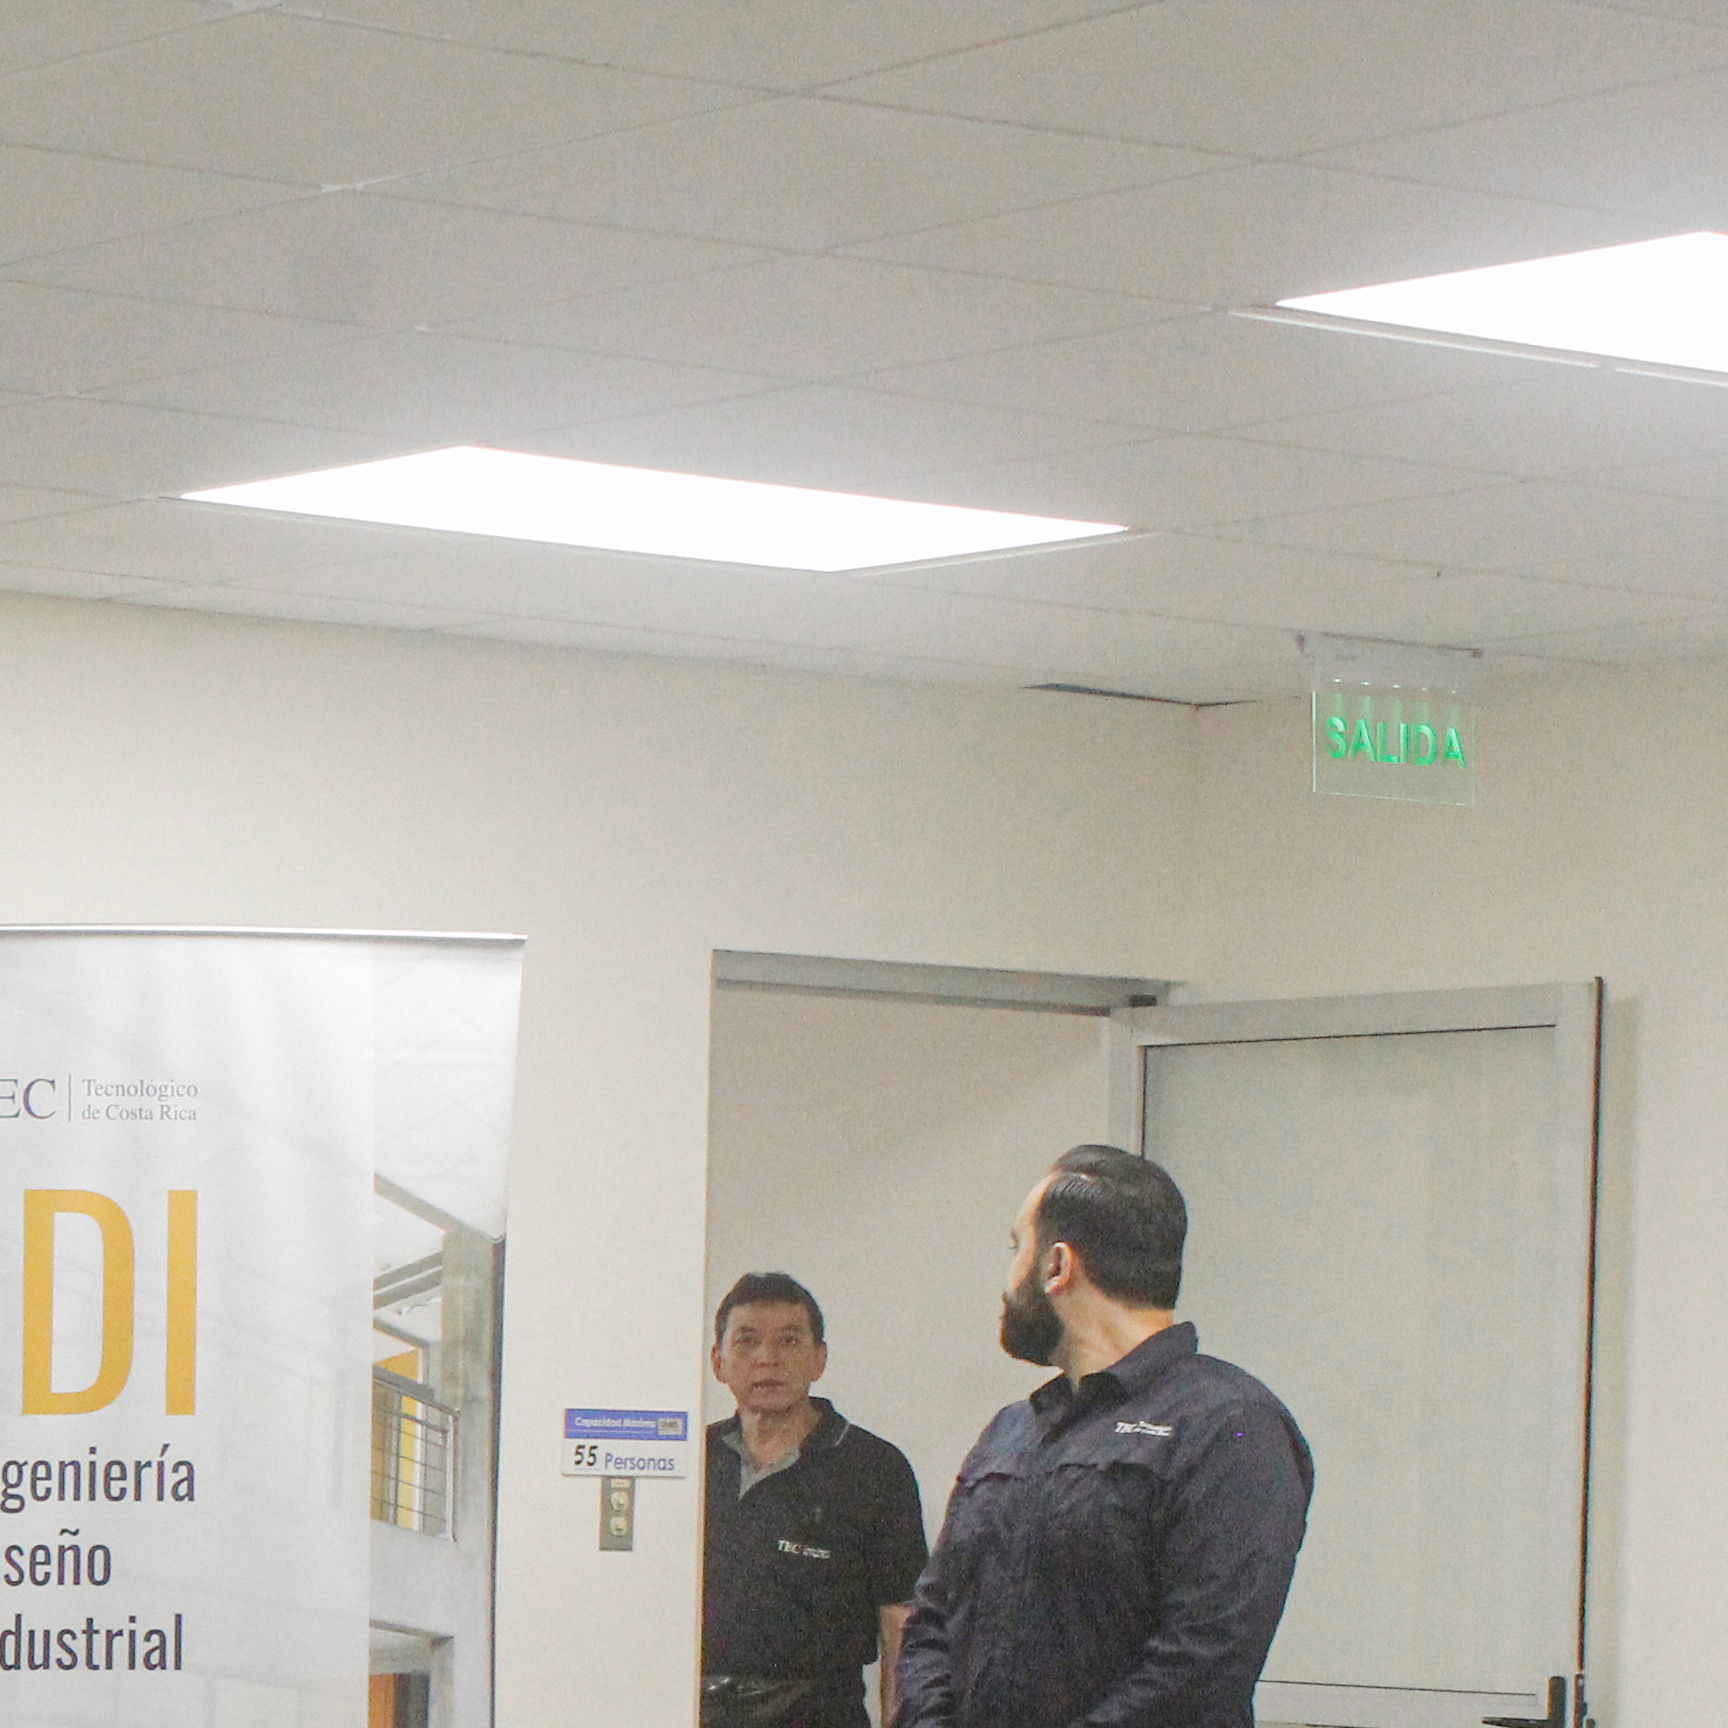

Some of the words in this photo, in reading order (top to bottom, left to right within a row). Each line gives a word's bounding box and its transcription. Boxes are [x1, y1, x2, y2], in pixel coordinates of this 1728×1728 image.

[1325, 715, 1467, 769] SALIDA
[81, 1078, 199, 1102] Tecnológico
[81, 1104, 101, 1121] de
[105, 1104, 154, 1121] Costa
[159, 1104, 198, 1121] Rica
[574, 1444, 599, 1467] 55
[604, 1452, 675, 1471] Personas
